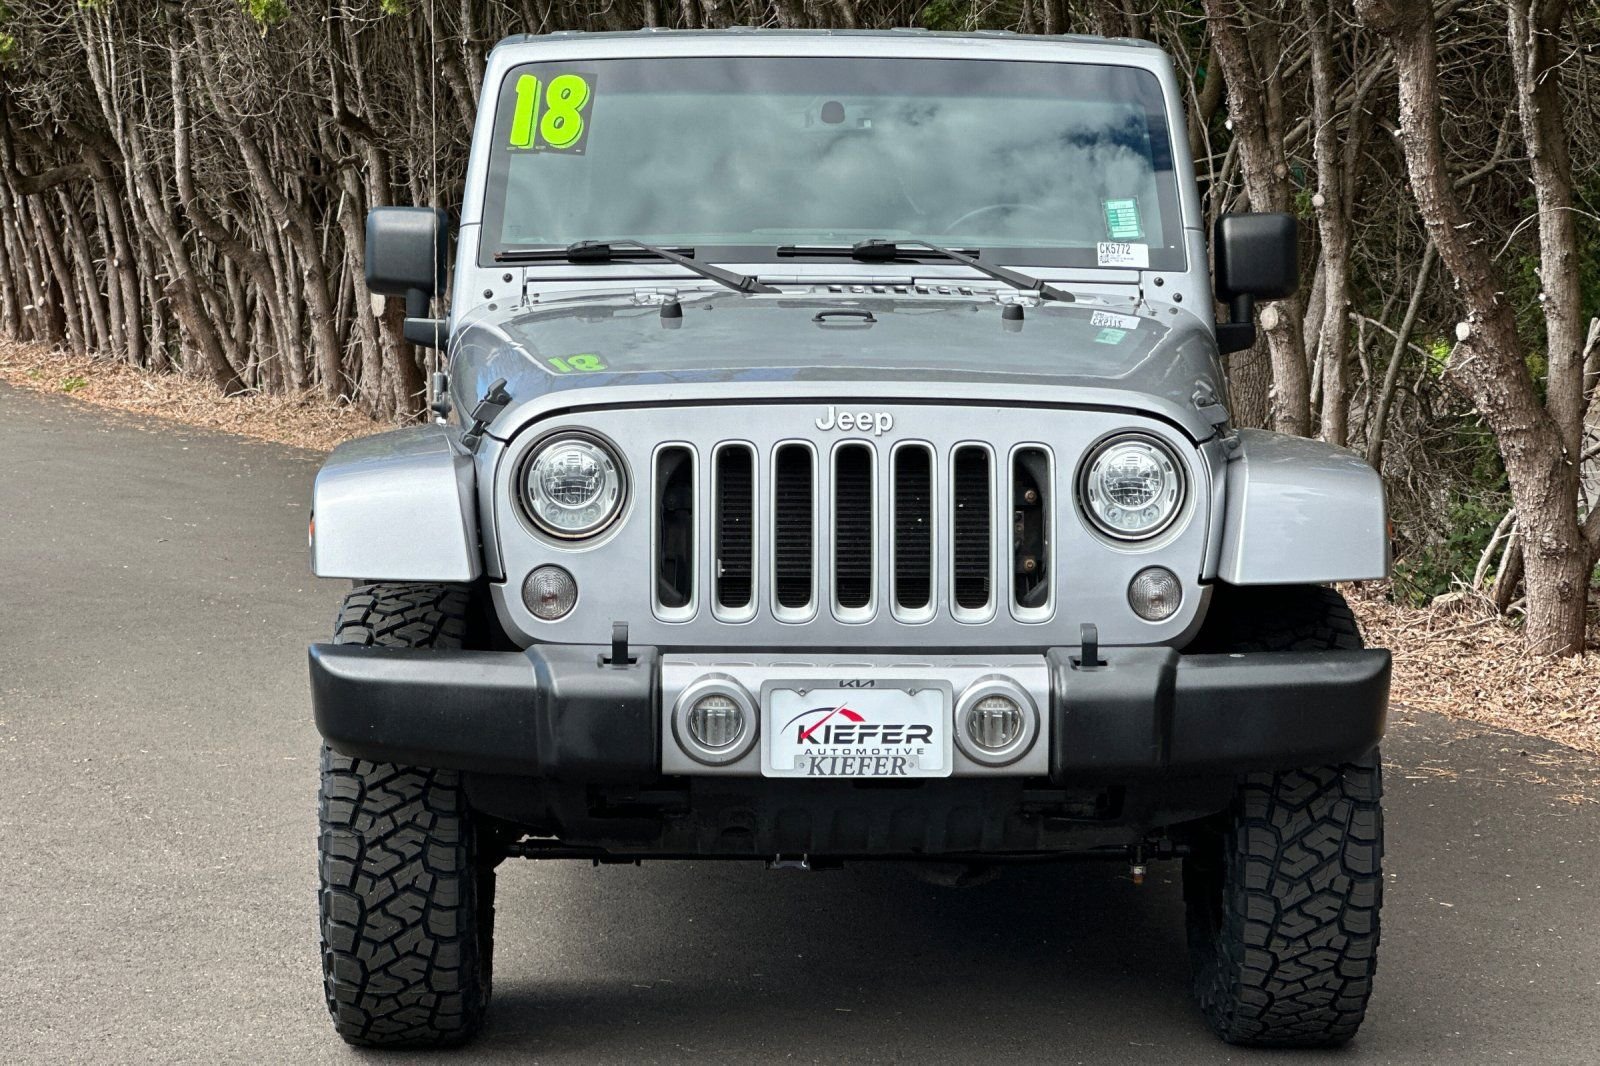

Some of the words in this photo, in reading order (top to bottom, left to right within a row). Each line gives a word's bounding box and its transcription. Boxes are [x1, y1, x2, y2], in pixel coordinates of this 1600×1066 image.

[509, 74, 590, 149] 18
[1099, 243, 1131, 255] CK5772
[815, 405, 894, 437] Jeep
[797, 724, 933, 745] KIEFER
[804, 747, 925, 755] AUTOMOTIVE
[807, 756, 907, 776] KIEFER
